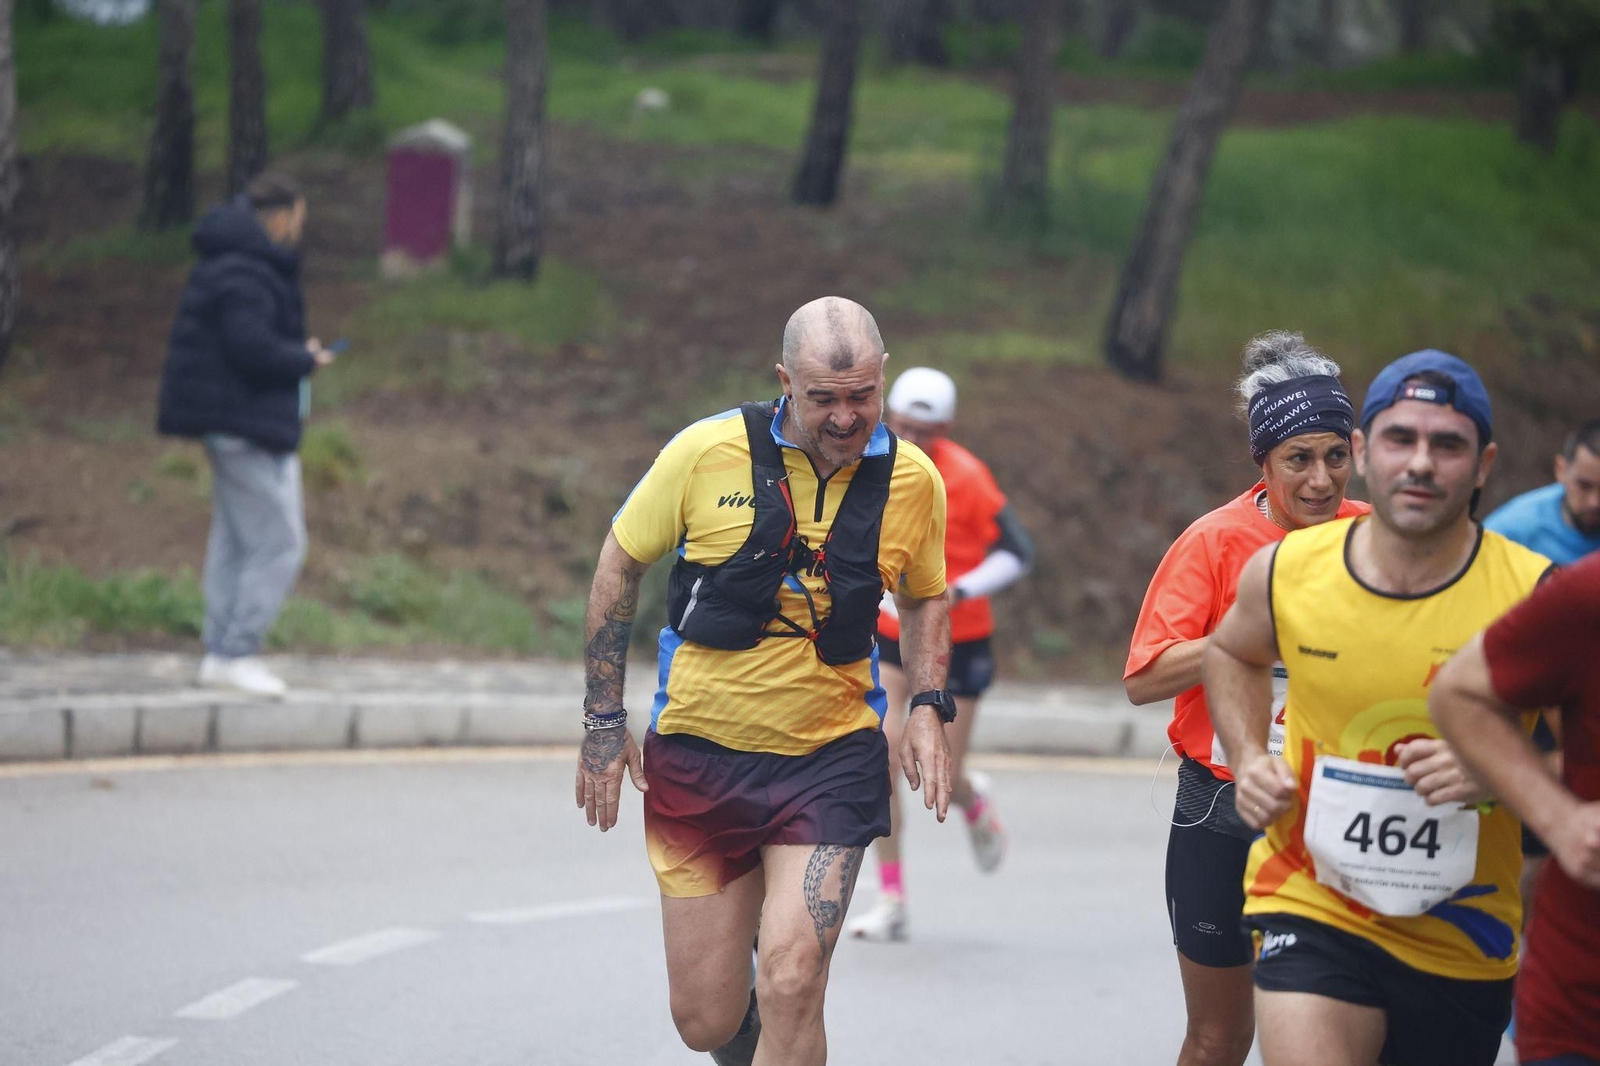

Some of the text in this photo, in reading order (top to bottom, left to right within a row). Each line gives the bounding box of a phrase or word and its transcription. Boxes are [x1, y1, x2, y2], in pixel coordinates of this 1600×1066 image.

[1264, 390, 1308, 416] HUAWEI
[1270, 400, 1313, 433] HUAWEI
[1343, 811, 1441, 859] 464
